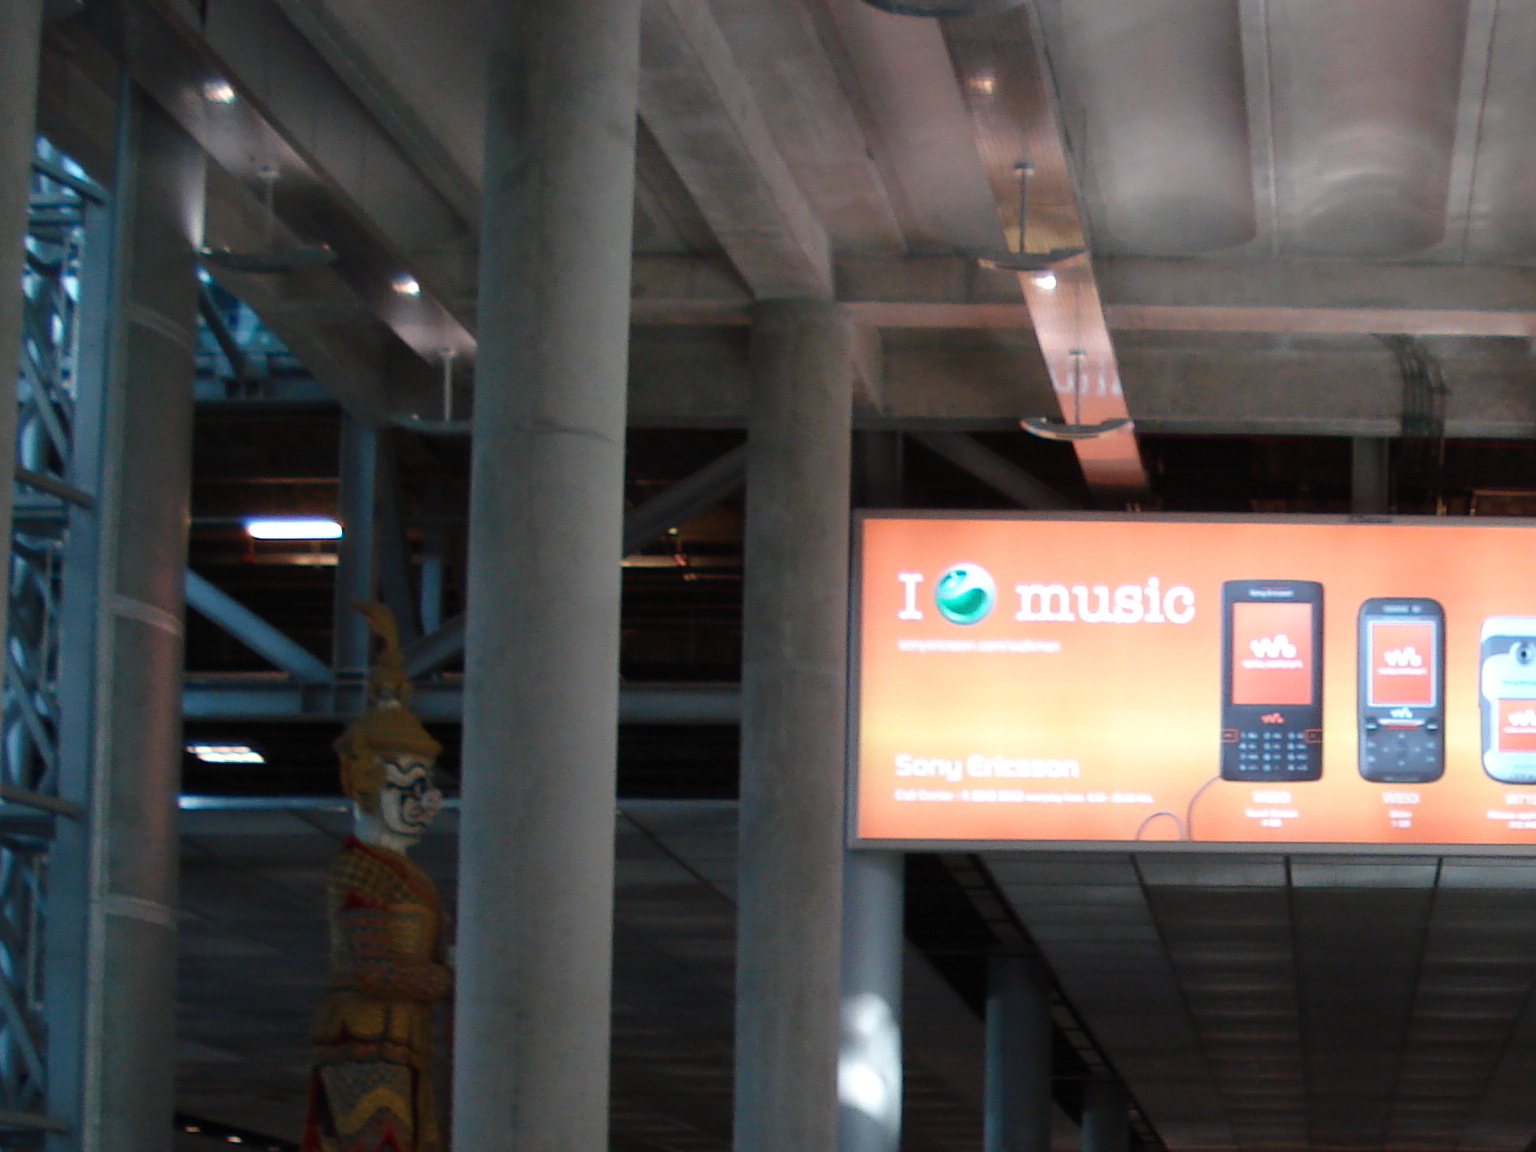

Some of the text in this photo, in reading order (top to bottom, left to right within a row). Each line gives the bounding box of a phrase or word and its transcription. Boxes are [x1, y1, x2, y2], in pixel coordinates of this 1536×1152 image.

[897, 572, 1197, 625] I music
[894, 753, 1080, 782] Sony Ericsson
